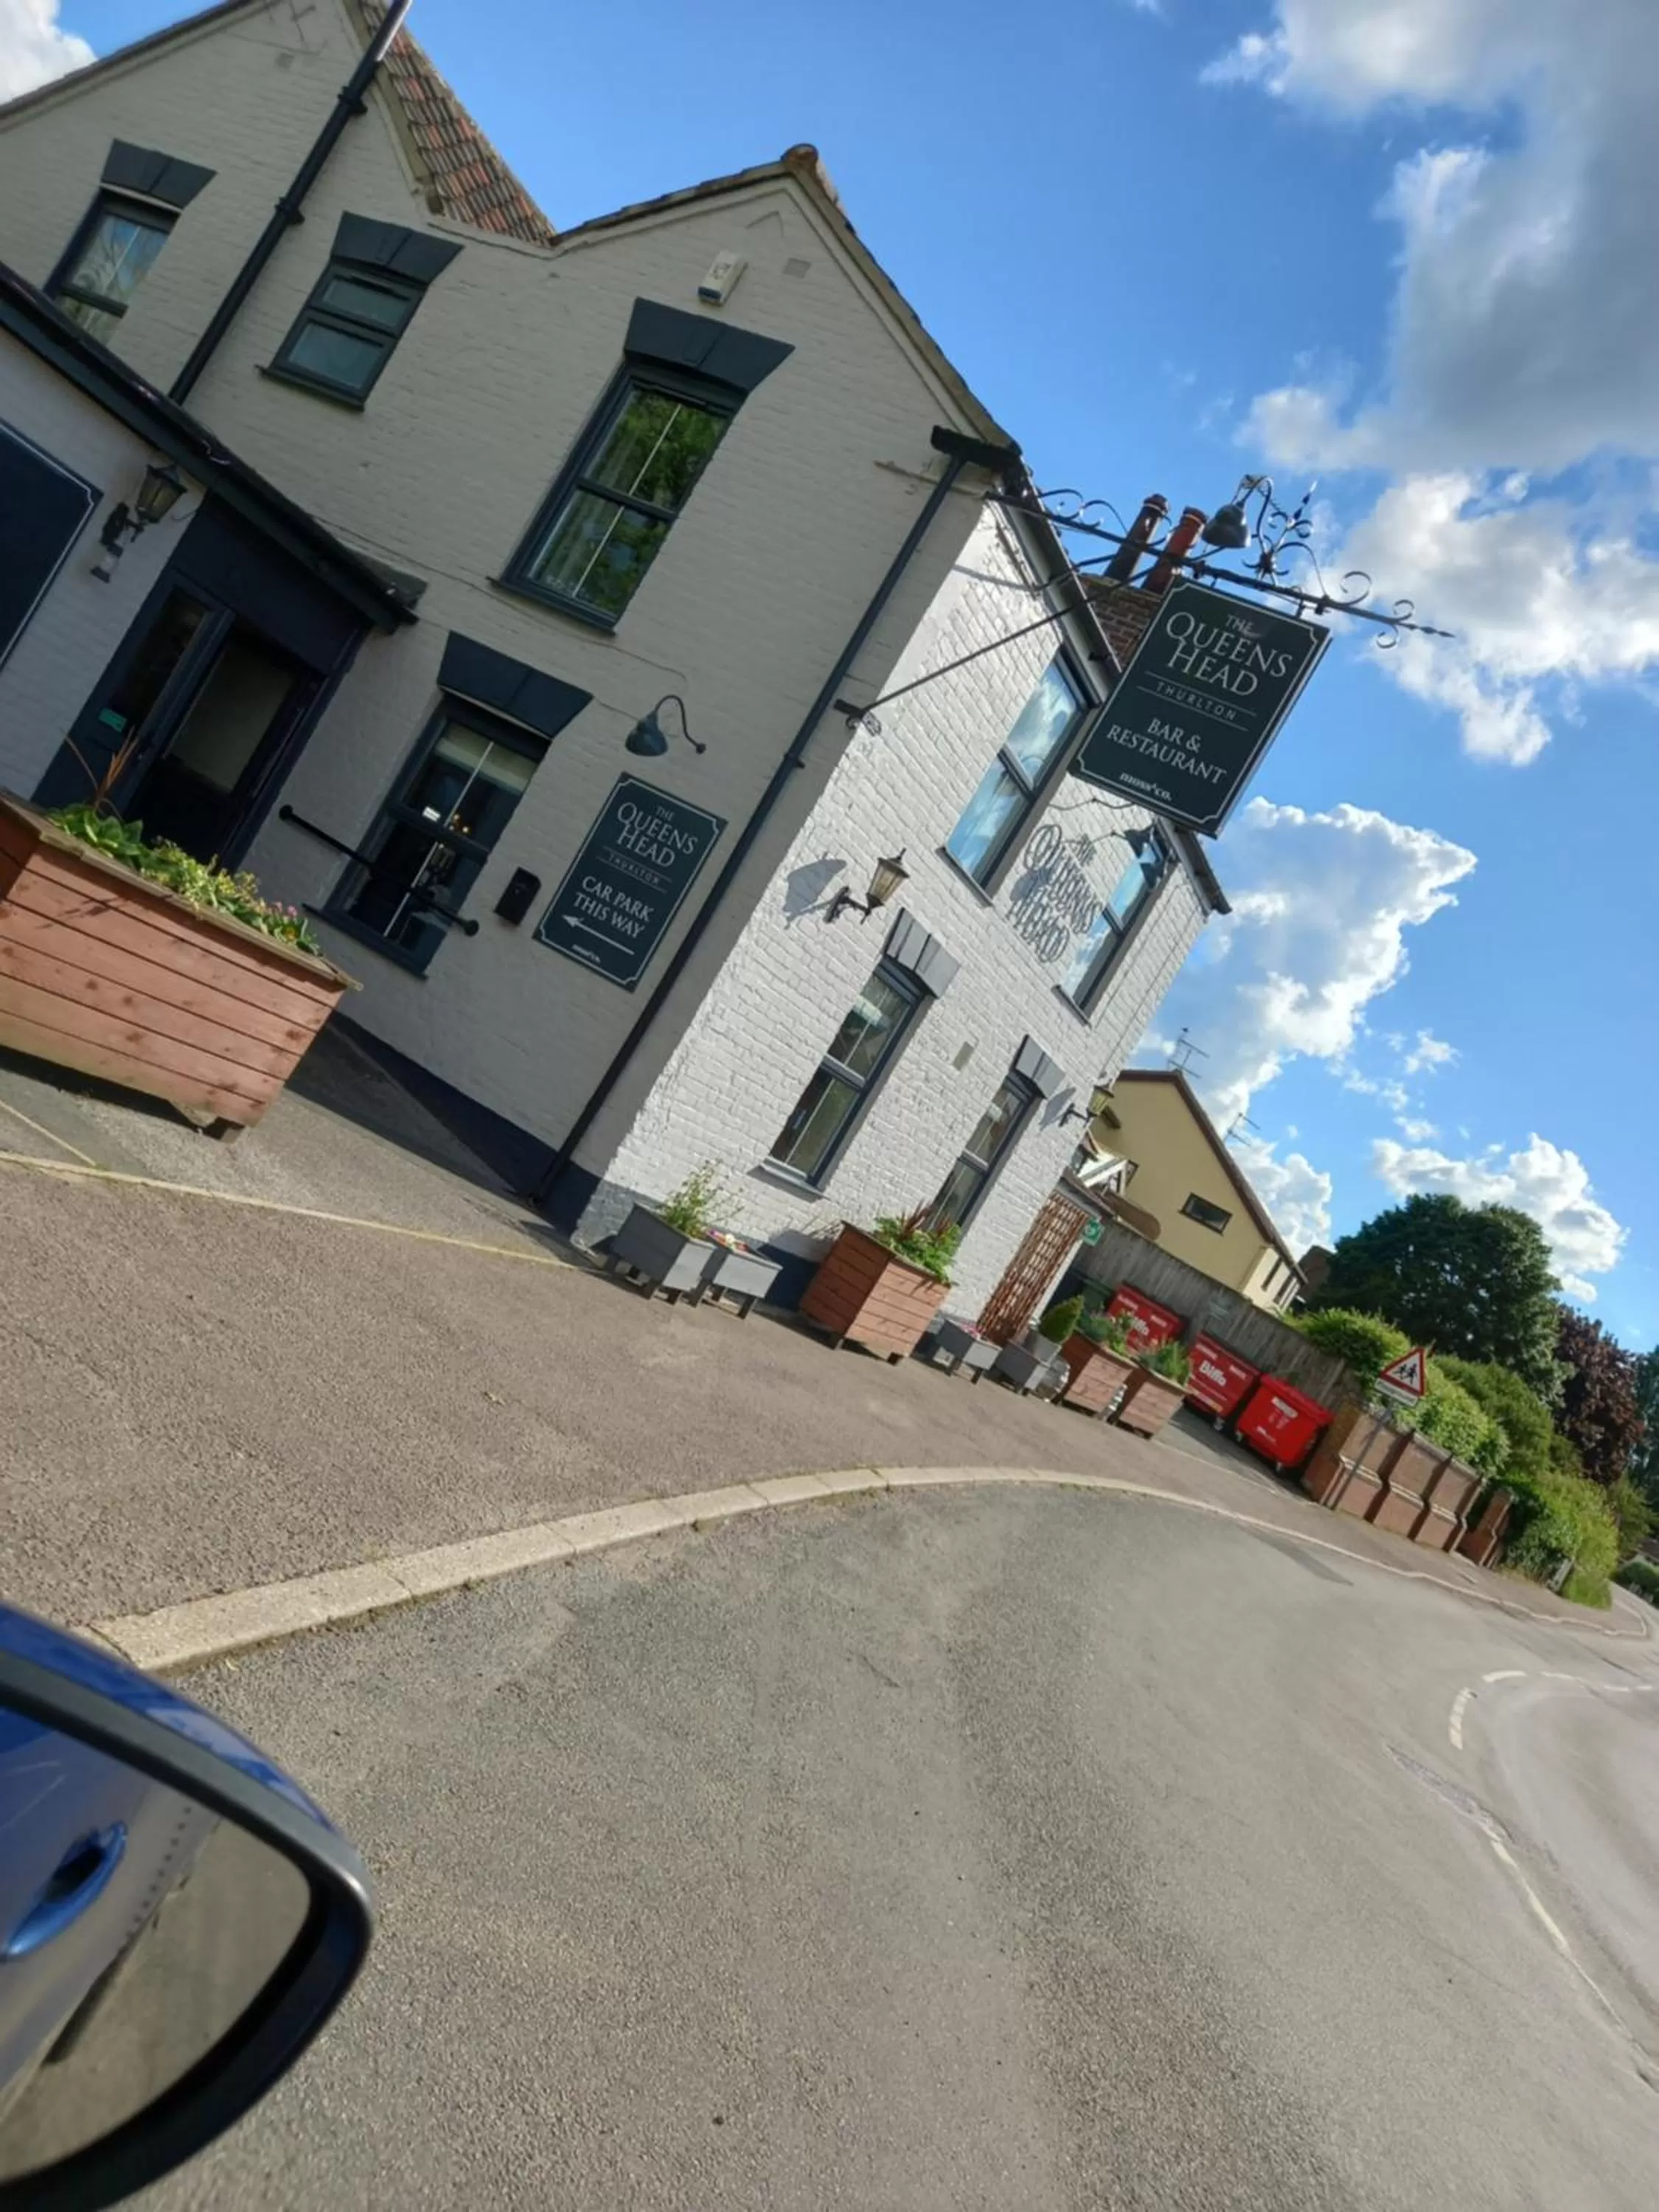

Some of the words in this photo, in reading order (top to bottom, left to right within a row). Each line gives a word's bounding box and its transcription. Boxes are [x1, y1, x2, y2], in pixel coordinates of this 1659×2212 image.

[1166, 611, 1293, 678] QUEENS
[1168, 642, 1259, 696] HEAD
[1155, 681, 1237, 720] THURLTON
[1106, 723, 1227, 784] RESTAURANT
[1147, 717, 1185, 745] BAR
[1186, 734, 1202, 753] &
[616, 824, 675, 867] HEAD
[617, 801, 698, 855] QUEENS
[573, 891, 609, 921] THIS
[612, 911, 645, 939] WAY
[582, 876, 613, 901] CAR
[613, 892, 655, 922] PARK
